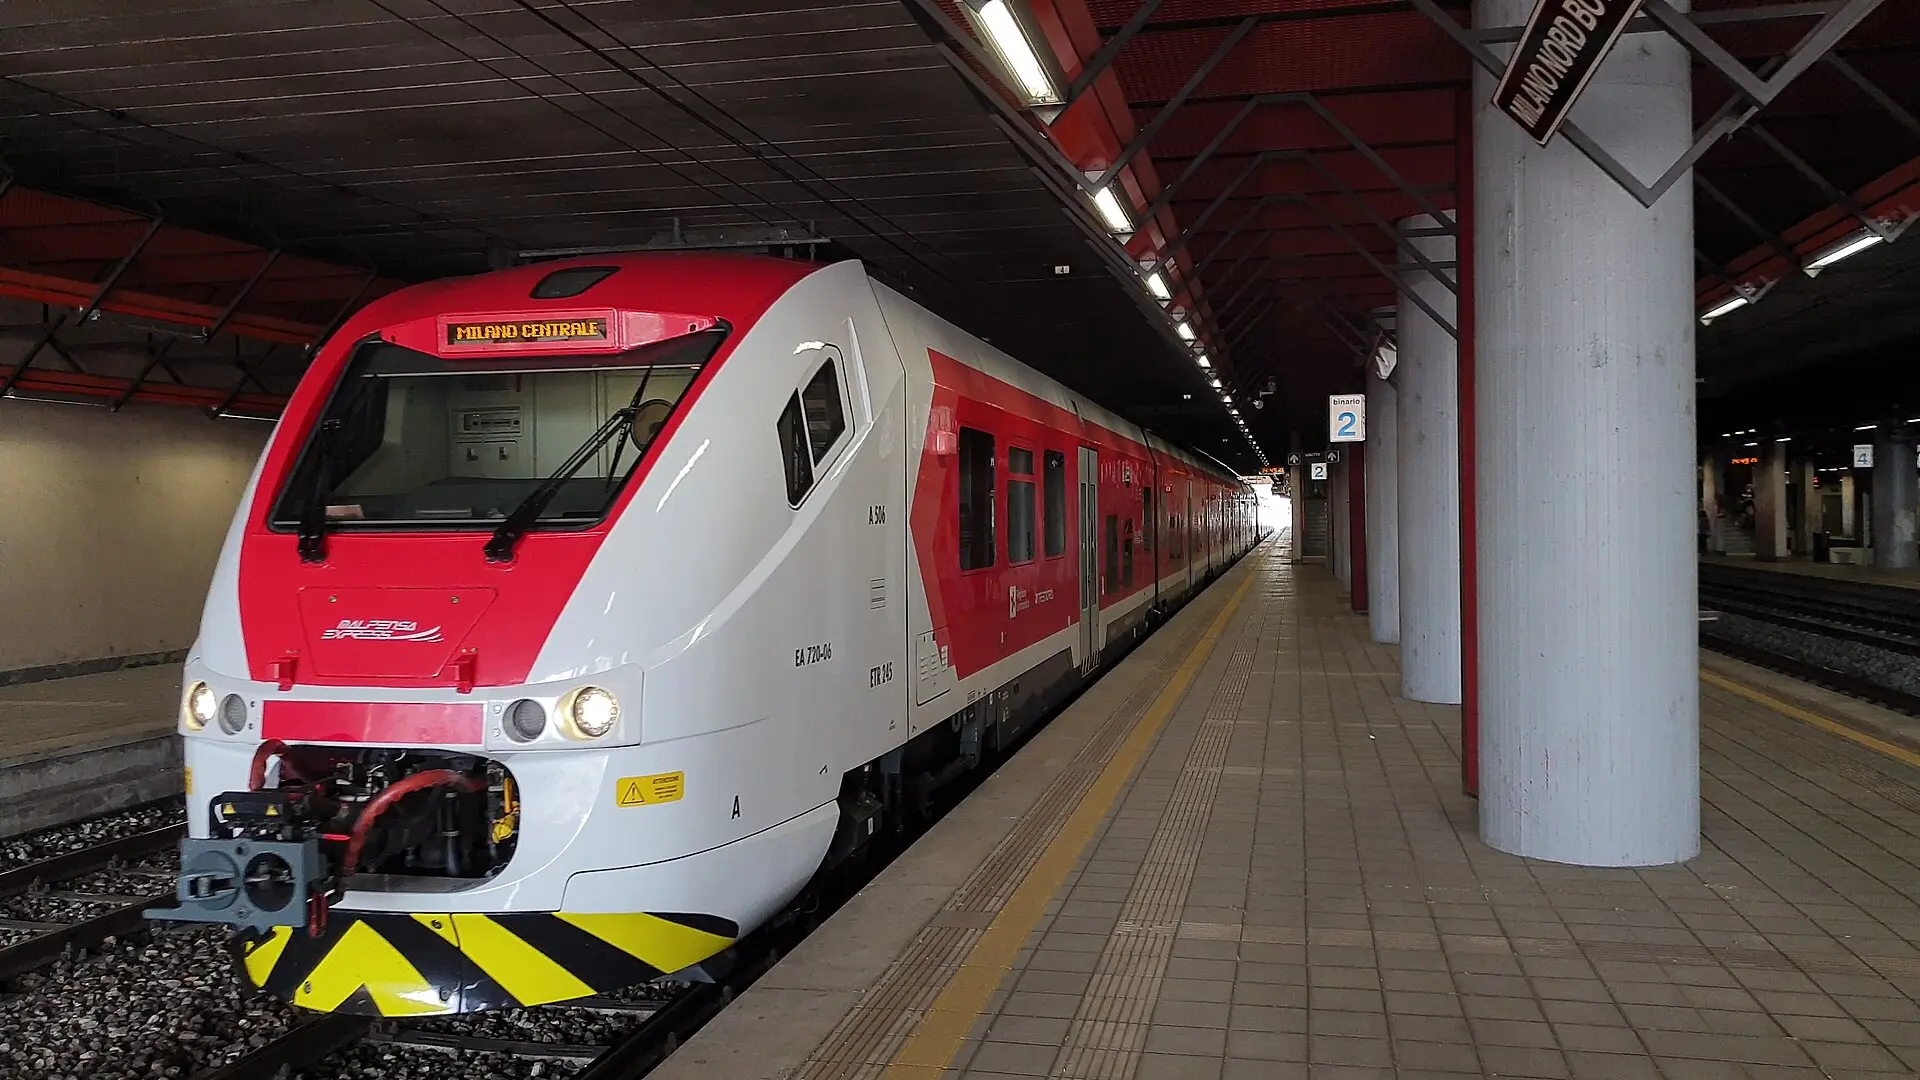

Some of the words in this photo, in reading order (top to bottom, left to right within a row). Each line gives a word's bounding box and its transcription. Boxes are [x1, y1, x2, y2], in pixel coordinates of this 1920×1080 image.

[1509, 63, 1559, 128] MILANO
[1536, 15, 1587, 79] NORD
[456, 324, 516, 340] MILANO
[521, 322, 599, 338] CENTRALE
[1333, 398, 1360, 406] binario
[1337, 412, 1356, 436] 2
[1858, 452, 1868, 464] 4
[1314, 466, 1324, 477] 2
[868, 506, 874, 525] A
[875, 505, 886, 524] 506
[795, 648, 806, 667] EA
[807, 642, 832, 664] 720-06
[870, 666, 881, 688] ETR
[882, 662, 893, 683] 245
[731, 794, 741, 820] A
